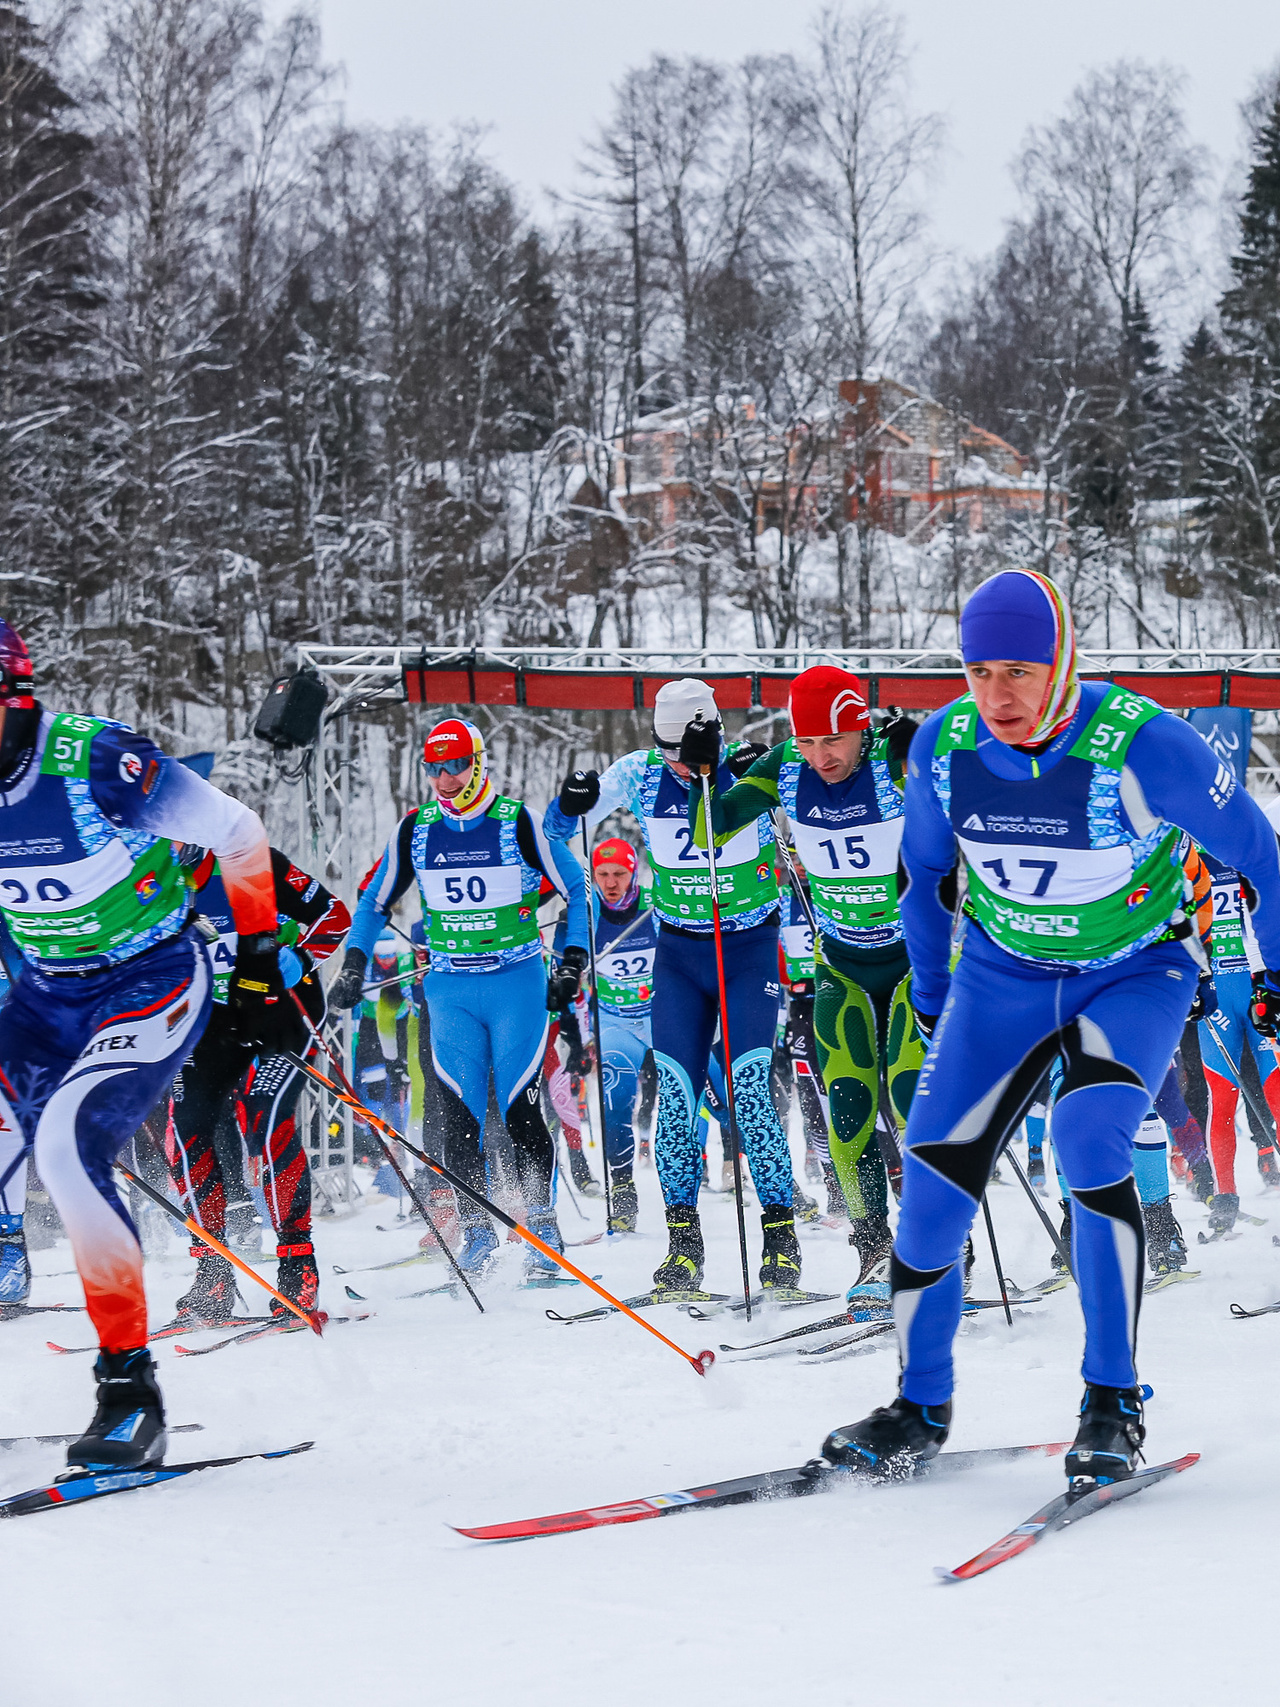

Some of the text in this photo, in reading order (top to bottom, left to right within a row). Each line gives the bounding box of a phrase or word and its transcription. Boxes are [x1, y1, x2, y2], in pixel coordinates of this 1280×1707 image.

[1090, 722, 1127, 752] 51
[53, 736, 84, 761] 51
[423, 806, 437, 819] 51
[498, 803, 517, 815] 51
[986, 822, 1069, 836] TOKSOVOCUP
[818, 835, 871, 870] 15
[982, 858, 1057, 896] 17
[445, 876, 486, 903] 50
[819, 892, 889, 905] TYRES
[441, 921, 497, 932] TYRES
[1212, 930, 1243, 939] TYR
[612, 957, 648, 977] 32
[1210, 1008, 1231, 1031] OIL
